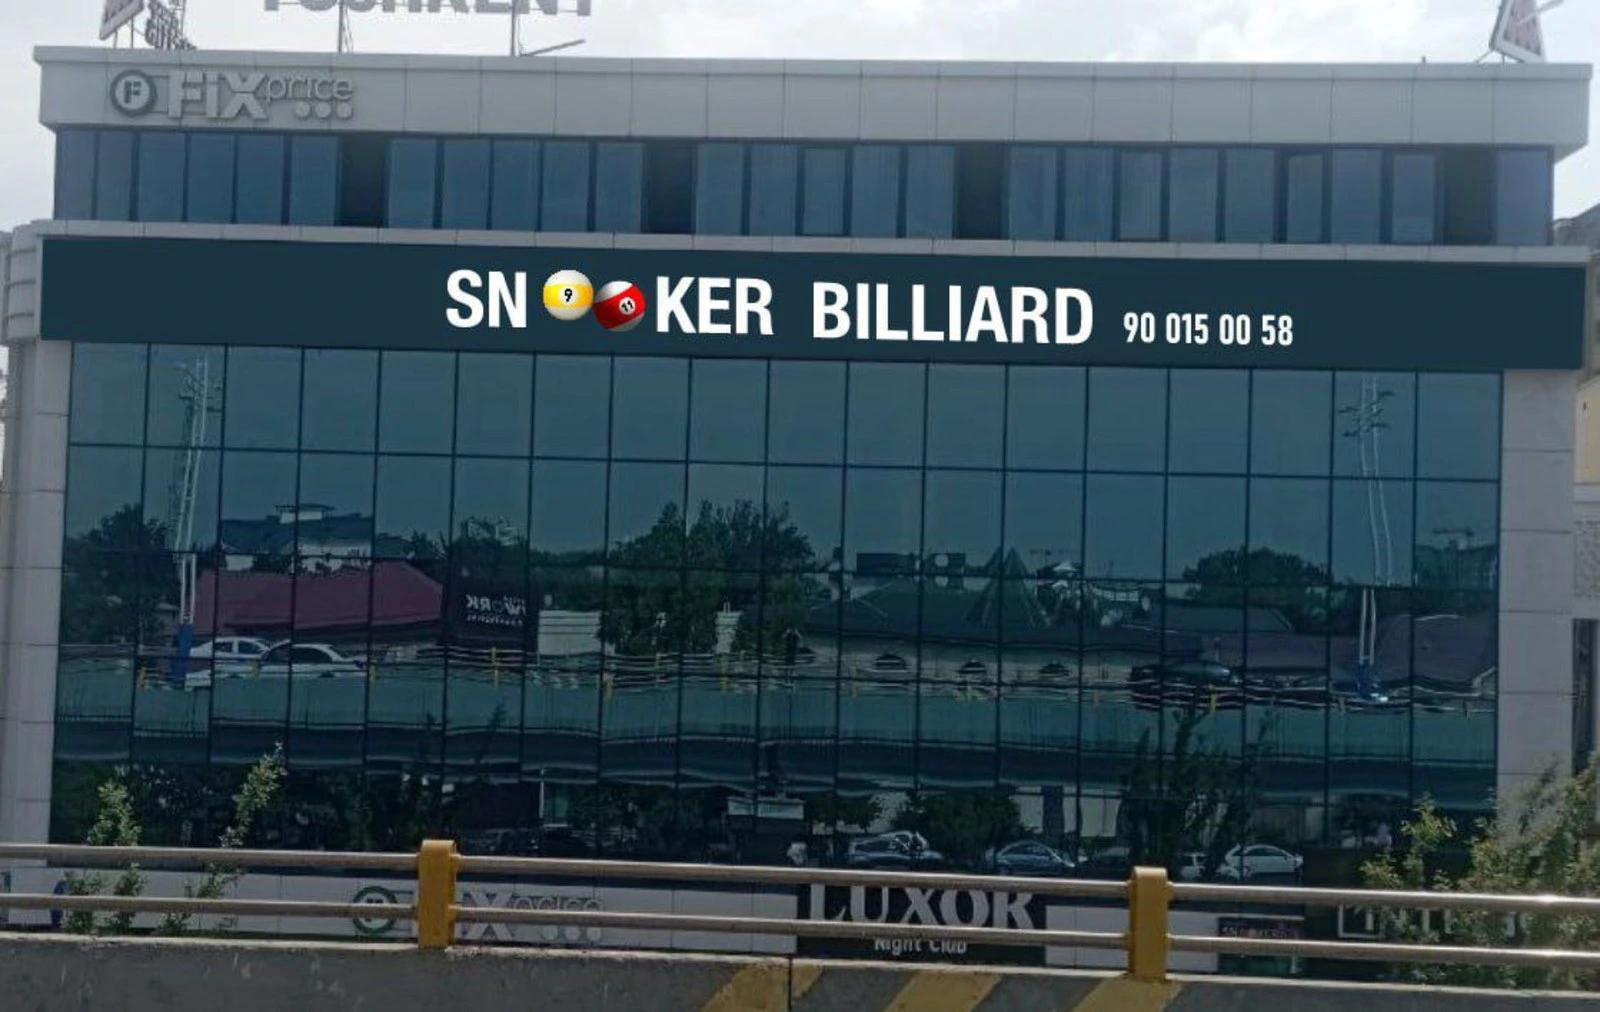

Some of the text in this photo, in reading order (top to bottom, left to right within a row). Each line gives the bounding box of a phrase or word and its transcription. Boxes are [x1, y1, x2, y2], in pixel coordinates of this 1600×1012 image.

[267, 76, 354, 103] price
[814, 282, 1092, 344] BILLIARD
[1124, 312, 1155, 342] 90
[1166, 313, 1208, 344] 015
[1220, 314, 1250, 344] 00
[1262, 315, 1292, 345] 58
